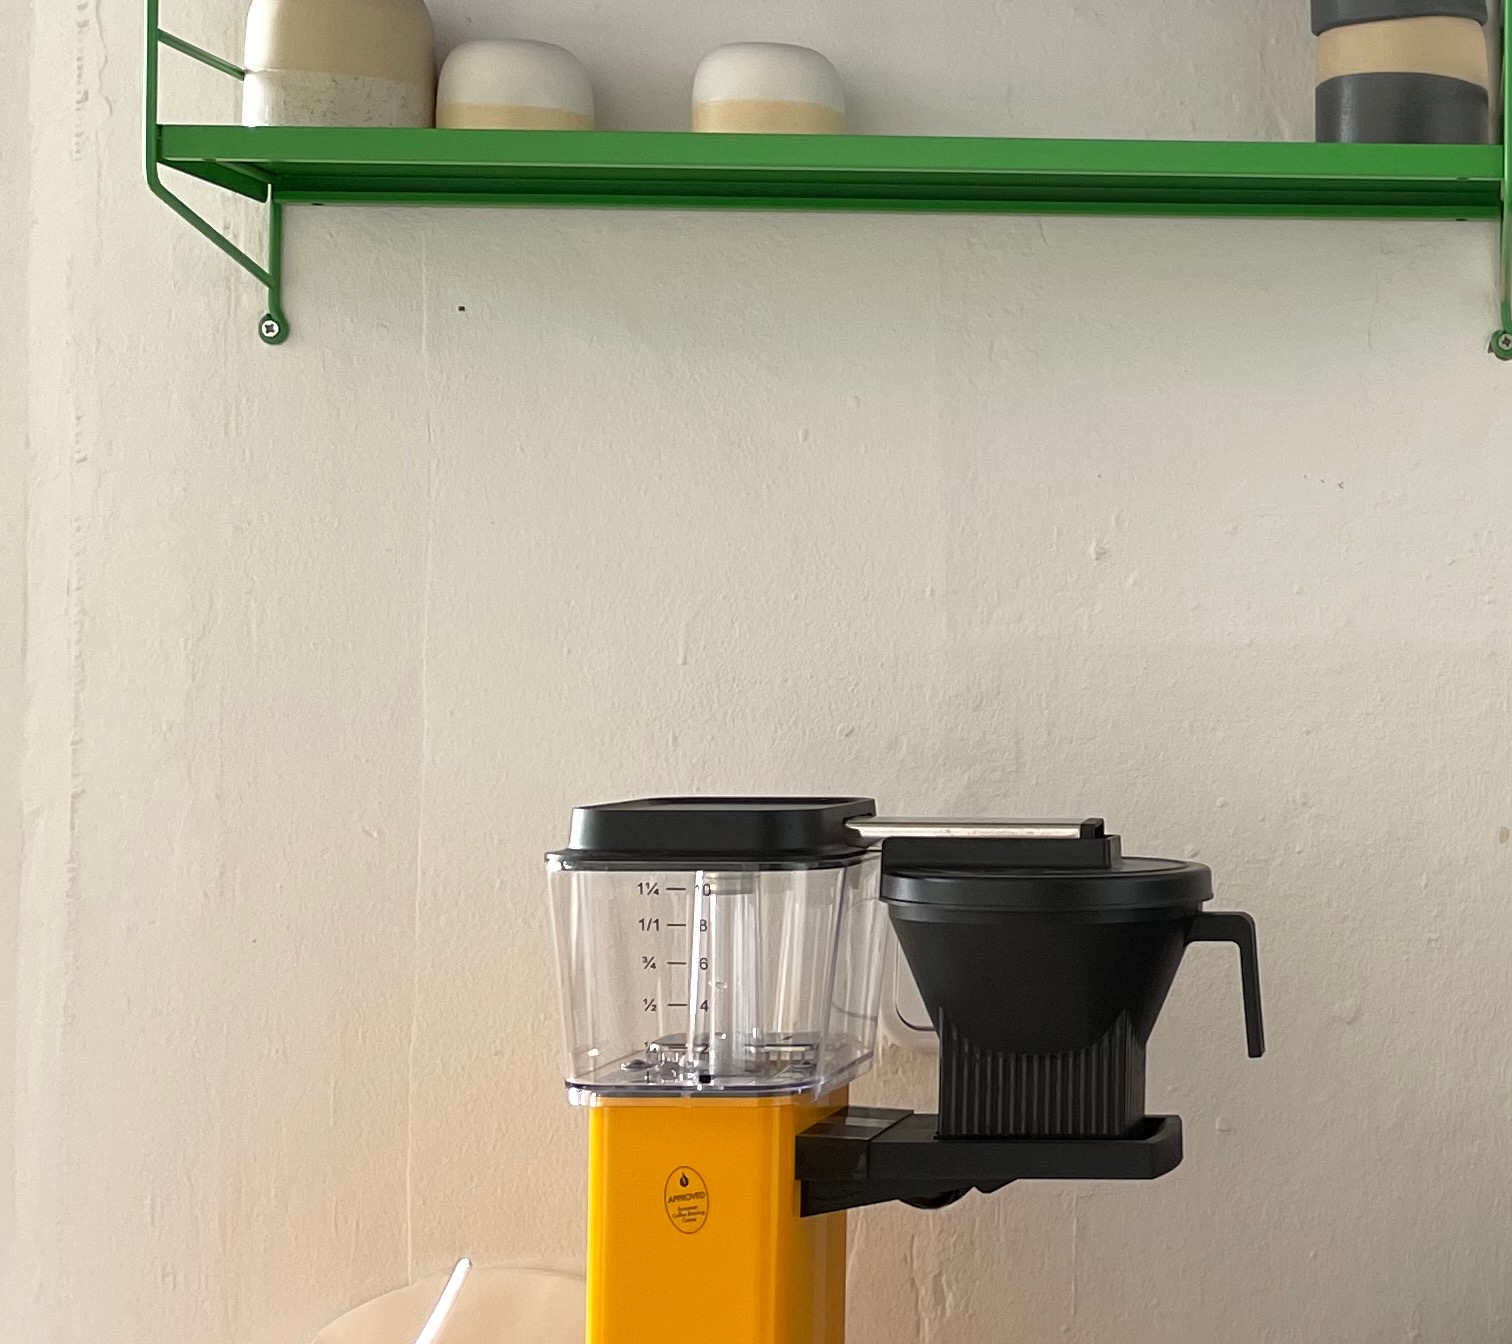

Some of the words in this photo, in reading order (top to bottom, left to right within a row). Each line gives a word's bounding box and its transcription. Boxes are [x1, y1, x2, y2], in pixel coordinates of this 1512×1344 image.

[639, 918, 659, 931] 1/1
[700, 919, 707, 932] 8
[700, 958, 708, 970] 6
[700, 1000, 708, 1012] 4
